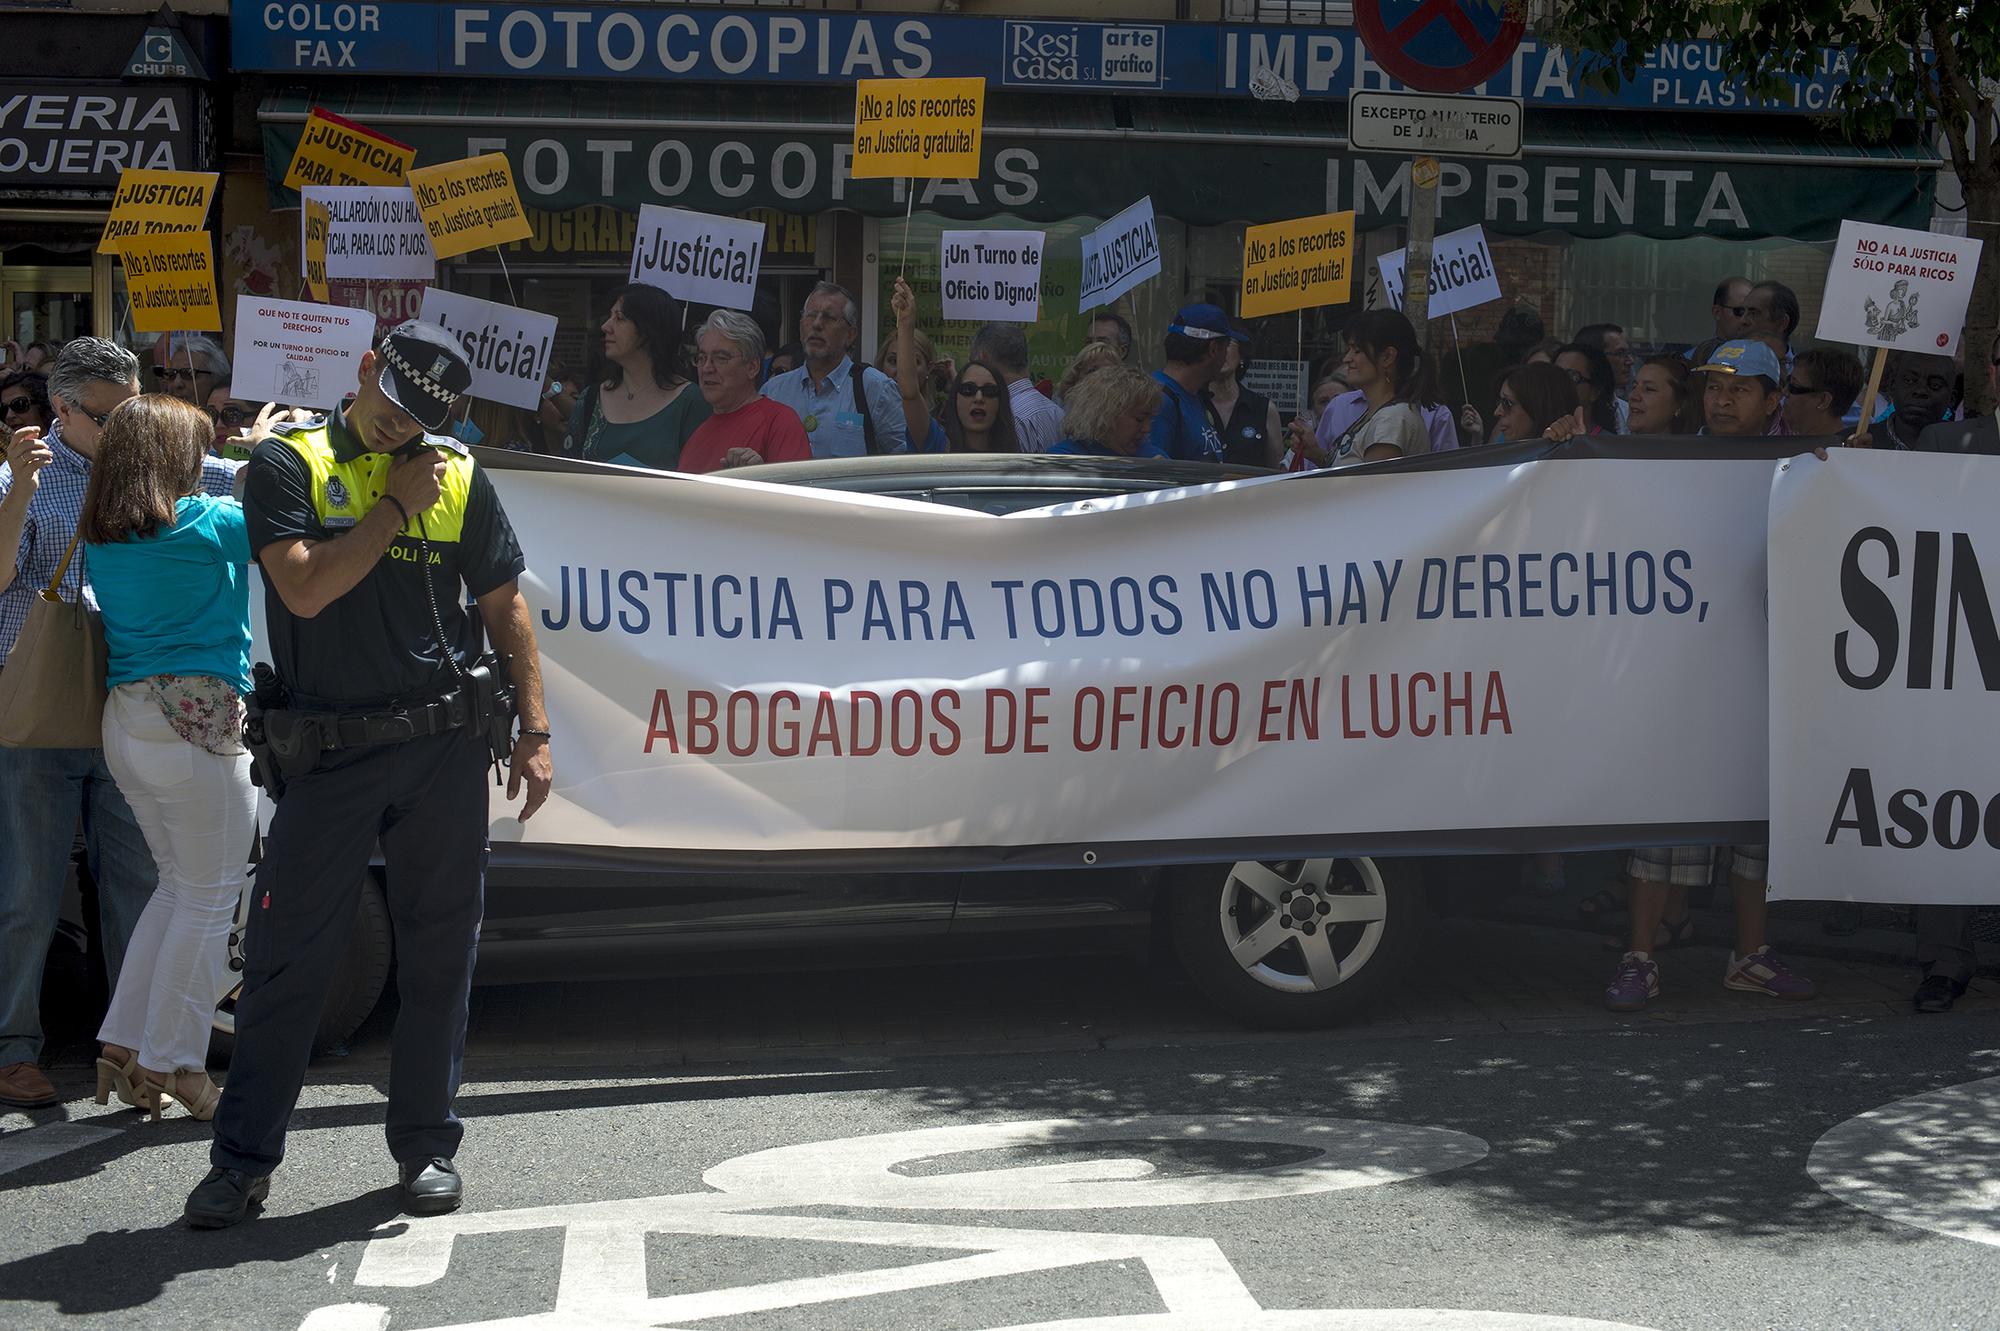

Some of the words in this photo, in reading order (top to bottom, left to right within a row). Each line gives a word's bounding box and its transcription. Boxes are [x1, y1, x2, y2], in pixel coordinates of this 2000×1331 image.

[264, 3, 380, 32] COLOR
[454, 9, 933, 78] FOTOCOPIAS
[1012, 24, 1079, 57] Resi
[1107, 31, 1153, 46] arte
[294, 40, 356, 67] FAX
[1105, 53, 1153, 77] gráfico
[131, 63, 187, 76] CHUBB
[1012, 56, 1079, 80] casa
[859, 94, 883, 124] ¡No
[884, 101, 894, 118] a
[896, 93, 917, 117] los
[920, 94, 976, 117] recortes
[1361, 106, 1426, 121] EXCEPTO
[858, 138, 872, 155] en
[874, 129, 920, 155] Justicia
[923, 129, 974, 159] gratuita!
[1393, 126, 1411, 137] DE
[305, 126, 404, 178] ¡JUSTICIA
[115, 184, 204, 208] ¡JUSTICIA
[416, 183, 438, 212] ¡No
[437, 185, 446, 202] a
[444, 177, 467, 199] los
[466, 168, 508, 193] recortes
[1325, 158, 1750, 229] IMPRENTA
[327, 195, 380, 223] GALLARDÓN
[382, 201, 389, 223] O
[391, 201, 403, 223] SU
[429, 220, 443, 239] en
[443, 206, 484, 234] Justicia
[483, 197, 521, 229] gratuita!
[351, 233, 376, 255] PARA
[377, 233, 395, 255] LOS
[400, 233, 427, 256] PIJOS.
[634, 227, 758, 285] ¡Justicia!
[945, 245, 969, 268] ¡Un
[974, 245, 1017, 265] Turno
[1021, 246, 1039, 265] de
[1102, 218, 1158, 283] JUSTICIA!
[1246, 239, 1267, 268] ¡No
[1269, 243, 1277, 259] a
[1278, 238, 1296, 257] los
[1298, 228, 1346, 254] recortes
[1856, 239, 1878, 254] NO
[1881, 244, 1889, 254] A
[1893, 245, 1907, 257] LA
[1909, 247, 1957, 265] JUSTICIA
[124, 251, 145, 279] ¡No
[144, 256, 151, 272] a
[149, 249, 168, 273] los
[167, 248, 207, 272] recortes
[1246, 277, 1259, 295] en
[1261, 266, 1299, 294] Justicia
[1300, 257, 1345, 291] gratuita!
[1852, 255, 1884, 273] SÓLO
[1888, 262, 1916, 277] PARA
[1919, 266, 1955, 282] RICOS
[132, 289, 145, 309] en
[145, 283, 179, 308] Justicia
[179, 282, 214, 313] gratuita!
[945, 280, 989, 300] Oficio
[994, 281, 1038, 307] Digno!
[258, 308, 276, 318] QUE
[277, 311, 290, 319] NO
[291, 312, 300, 320] TE
[301, 313, 333, 324] QUITEN
[334, 317, 350, 326] TUS
[282, 322, 323, 334] DERECHOS
[253, 340, 268, 348] POR
[269, 341, 280, 349] UN
[281, 343, 303, 352] TURNO
[304, 345, 314, 353] DE
[315, 346, 339, 356] OFICIO
[286, 353, 314, 362] CALIDAD
[542, 565, 803, 641] JUSTICIA
[823, 579, 975, 641] PARA
[991, 574, 1183, 639] TODOS
[1200, 569, 1279, 633] NO
[1297, 558, 1403, 628] HAY
[1416, 549, 1710, 624] DERECHOS,
[642, 688, 961, 758] ABOGADOS
[984, 687, 1050, 755] DE
[1072, 682, 1240, 753] OFICIO
[1257, 677, 1321, 742] EN
[1341, 670, 1513, 739] LUCHA
